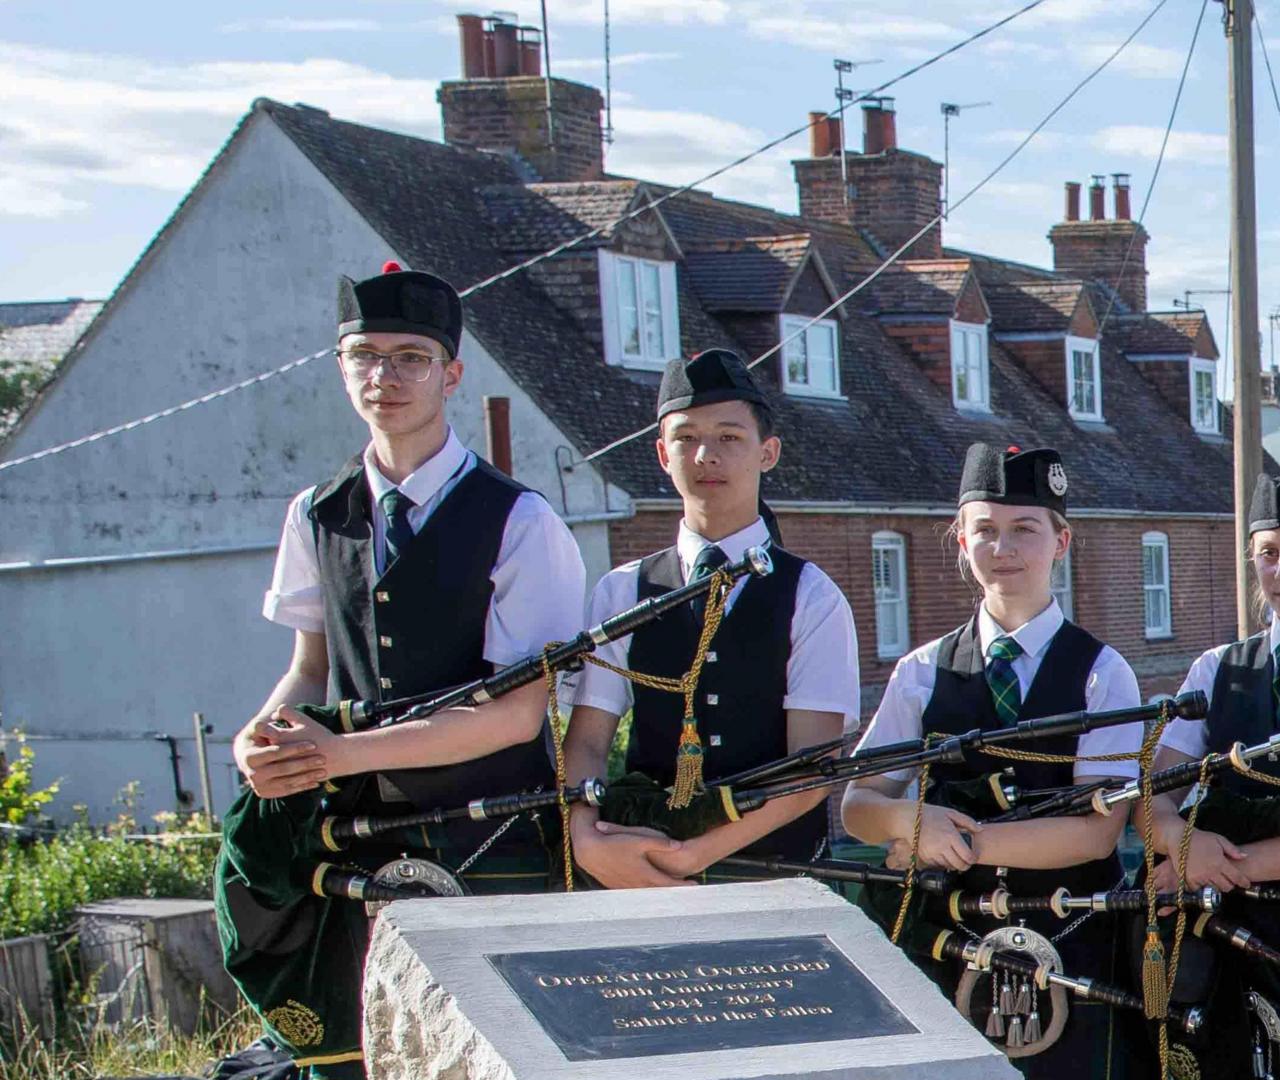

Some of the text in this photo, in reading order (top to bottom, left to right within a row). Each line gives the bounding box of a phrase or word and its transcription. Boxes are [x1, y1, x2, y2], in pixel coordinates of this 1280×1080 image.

[535, 960, 830, 987] OPERATION OVERLORD
[600, 977, 793, 999] 80th Anniversary
[649, 997, 703, 1011] 1944
[725, 992, 775, 1006] 2024
[613, 1004, 833, 1030] Salute to the Fallen
